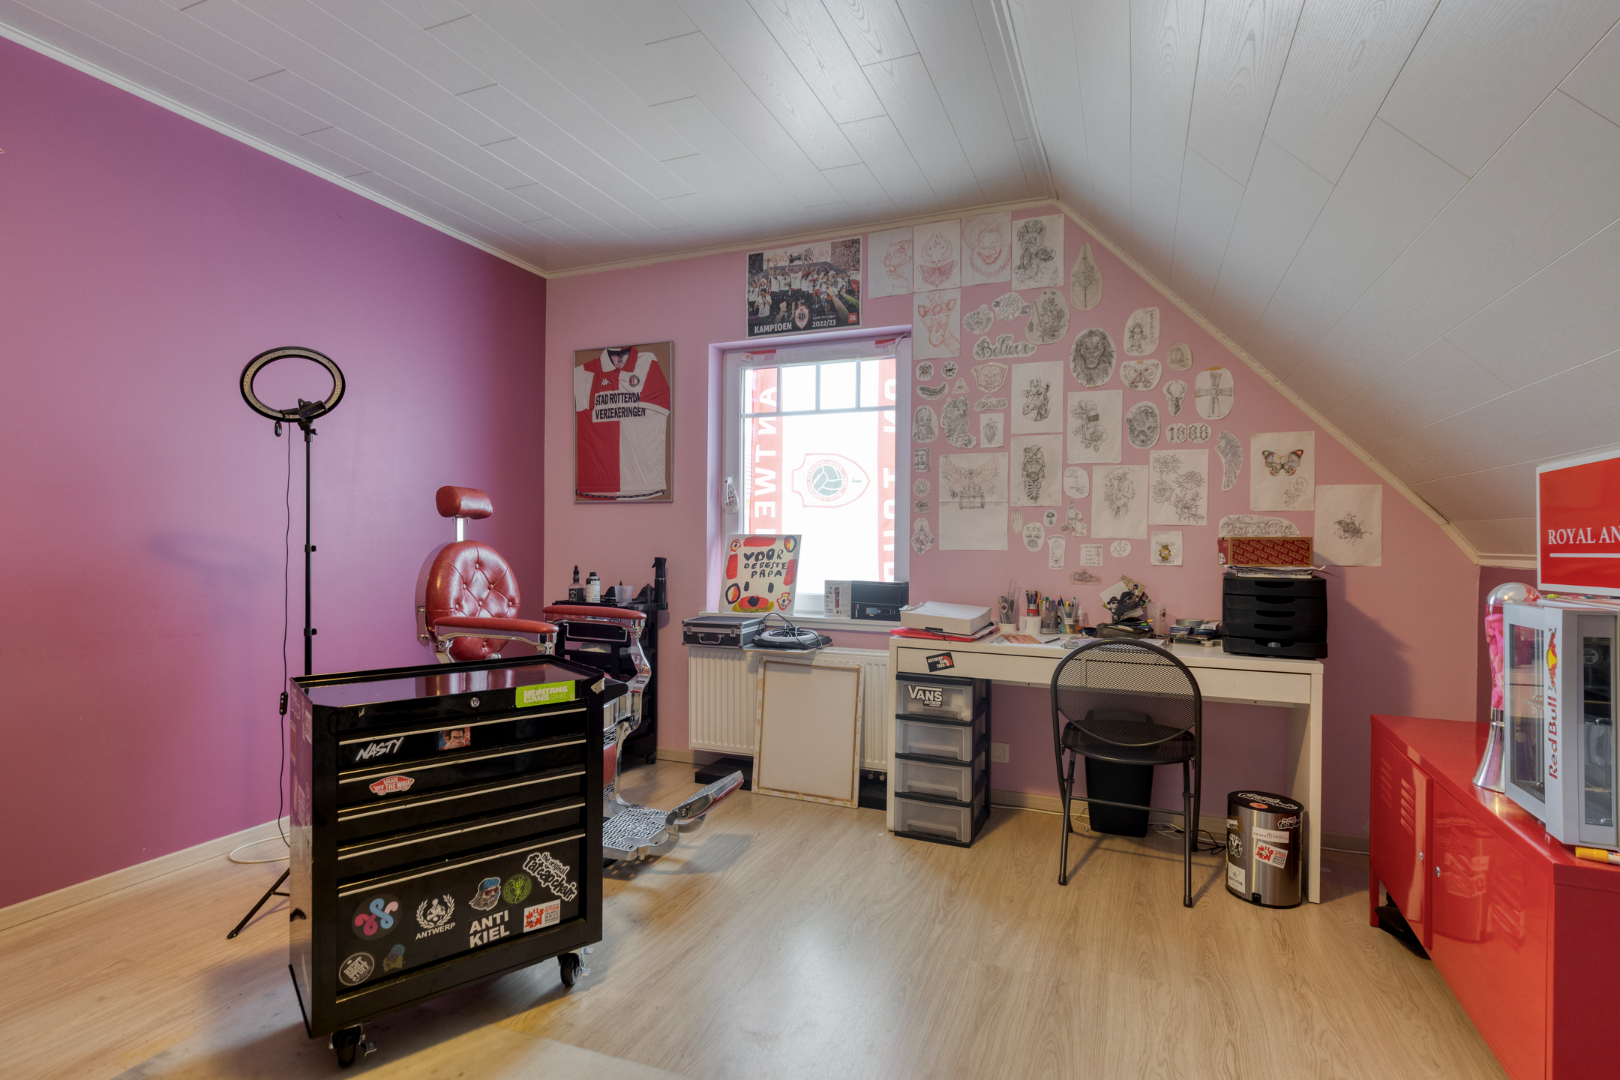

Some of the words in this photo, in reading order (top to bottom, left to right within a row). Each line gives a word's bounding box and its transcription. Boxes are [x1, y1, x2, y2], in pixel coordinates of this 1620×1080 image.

[754, 322, 792, 334] KAMPIOEN
[812, 319, 836, 328] 2022/23
[595, 394, 608, 406] STAD
[595, 406, 646, 420] VERZEKERINGEN
[1548, 527, 1596, 545] ROYAL
[743, 548, 784, 562] VOOR
[751, 569, 782, 579] PAPA
[523, 685, 568, 697] MONTANA
[523, 694, 550, 703] CANS
[907, 684, 943, 702] VANS
[1547, 694, 1558, 737] Bull
[355, 736, 404, 761] NASTY
[1547, 736, 1558, 781] Red
[385, 783, 397, 791] THE
[469, 909, 509, 934] ANTI
[415, 922, 456, 941] ANTWERP
[469, 924, 510, 949] KIEL
[350, 961, 370, 982] STUFF
